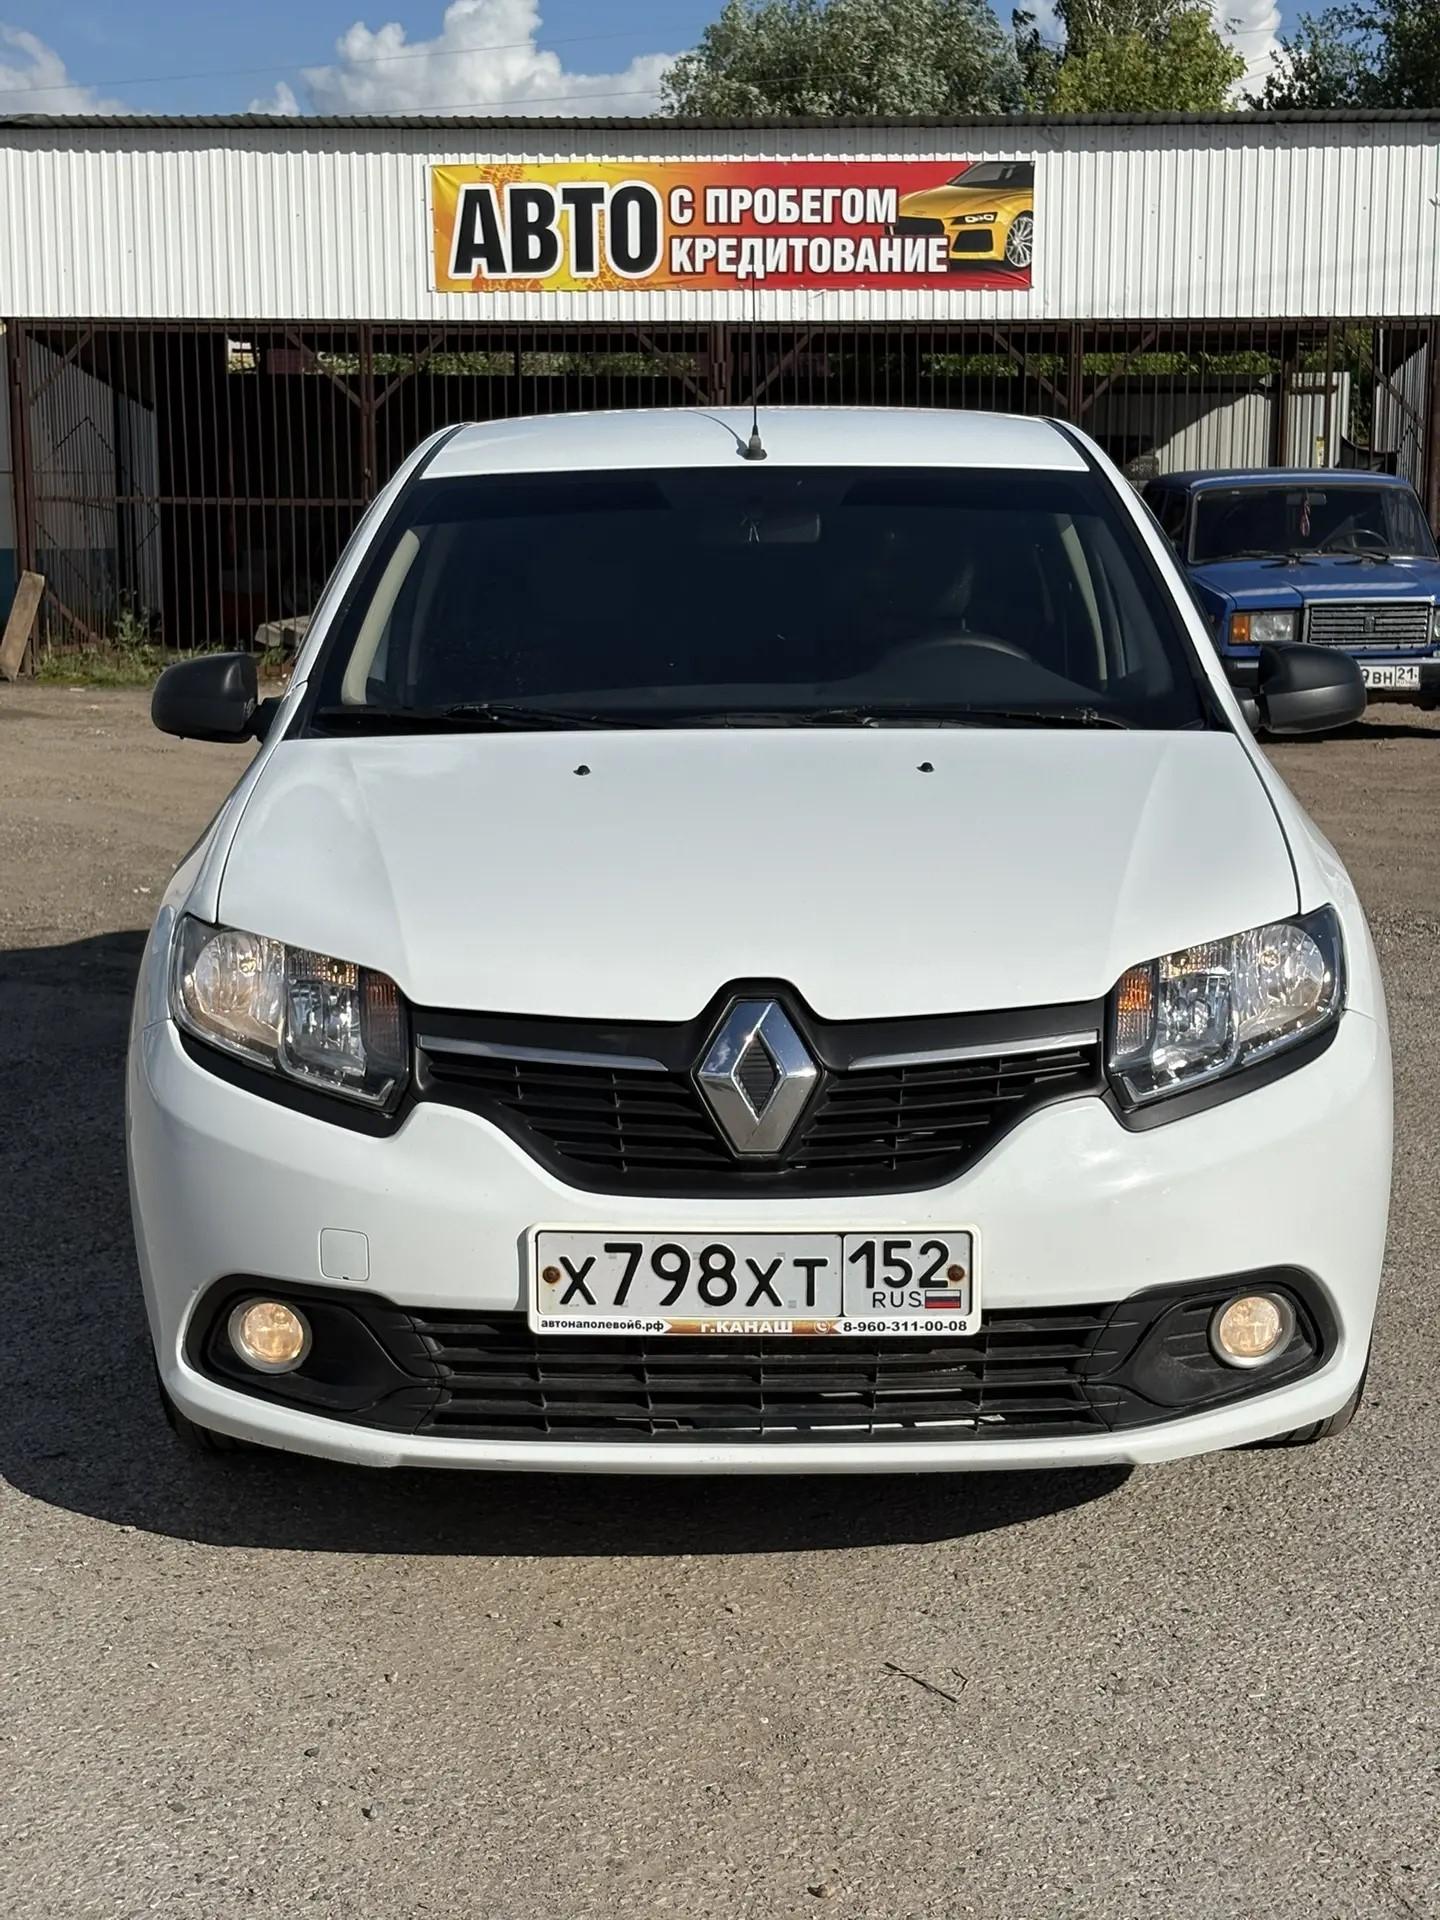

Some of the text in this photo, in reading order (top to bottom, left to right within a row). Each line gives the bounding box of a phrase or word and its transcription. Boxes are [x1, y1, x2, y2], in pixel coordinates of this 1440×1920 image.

[670, 187, 897, 224] С ПРОБЕГОМ
[453, 184, 657, 278] АВТО
[671, 237, 948, 278] КРЕДИТОВАНИЕ
[848, 1240, 949, 1289] 152
[872, 1291, 923, 1308] RUS
[700, 1320, 793, 1333] г.КАНАШ
[843, 1320, 967, 1332] 8-960-311-00-08
